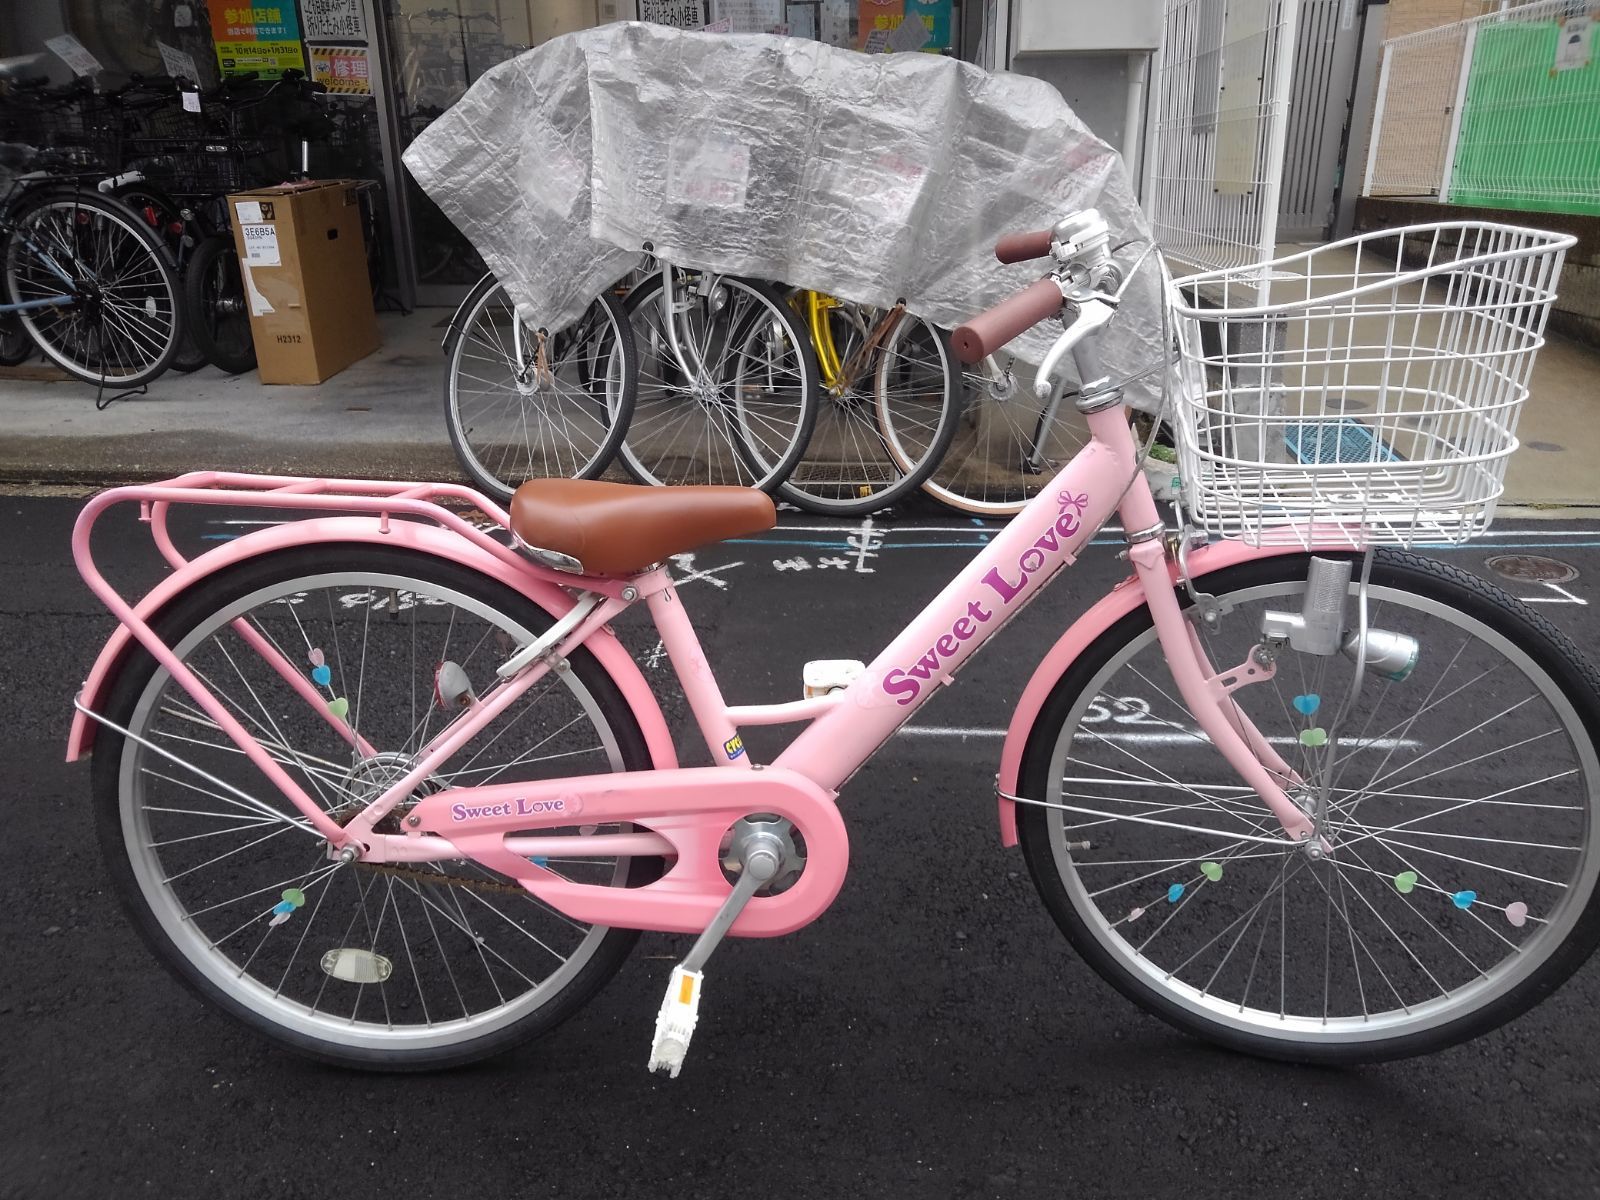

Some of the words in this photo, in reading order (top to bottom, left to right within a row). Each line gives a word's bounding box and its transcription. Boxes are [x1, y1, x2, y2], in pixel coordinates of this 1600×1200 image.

[224, 8, 281, 25] 参加店舗
[334, 58, 368, 78] 修理
[245, 227, 276, 236] 3E6B5A
[882, 600, 992, 705] Sweet
[981, 512, 1080, 604] Love
[452, 801, 511, 821] Sweet
[516, 798, 564, 815] Love
